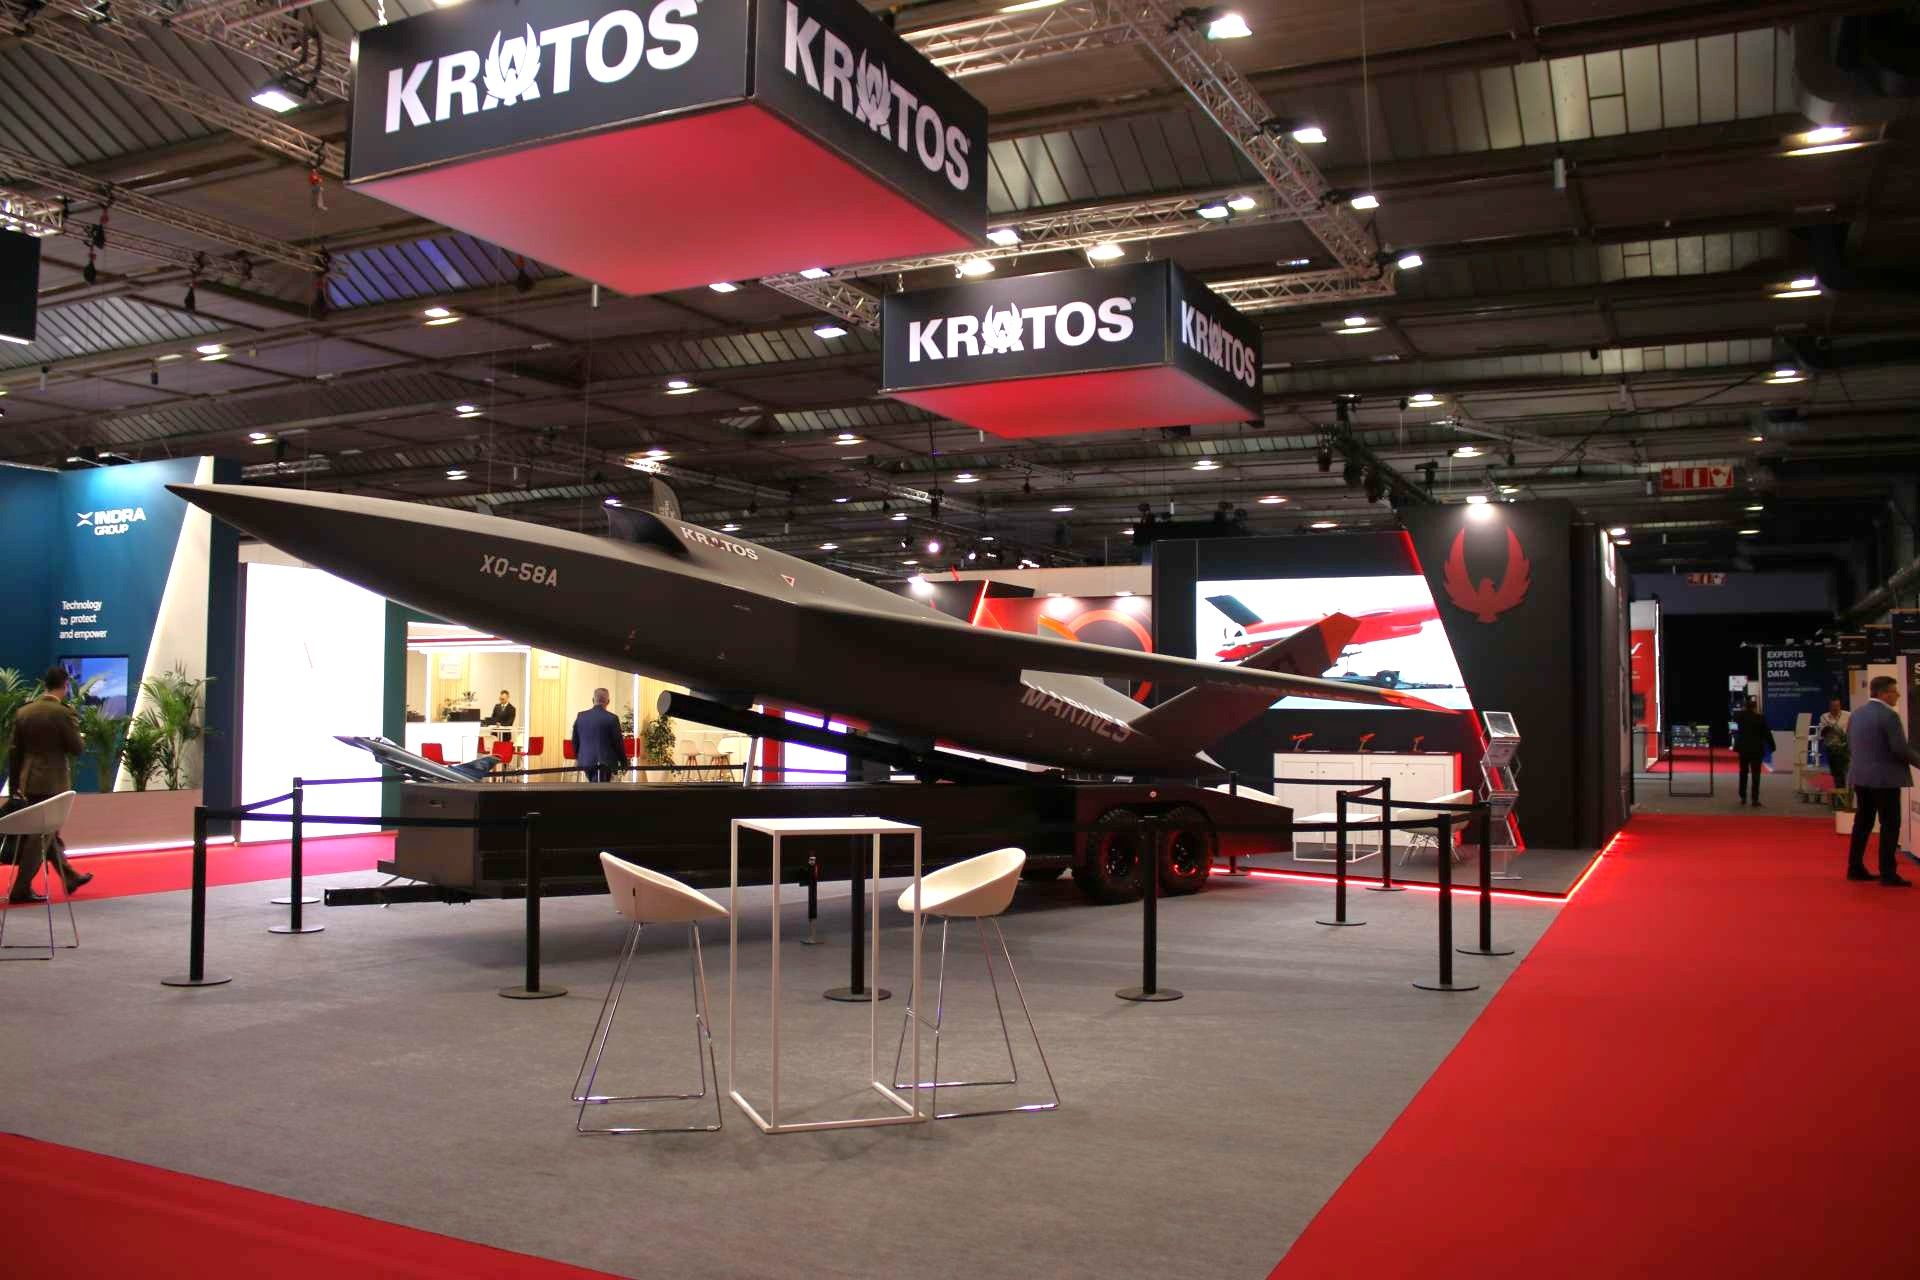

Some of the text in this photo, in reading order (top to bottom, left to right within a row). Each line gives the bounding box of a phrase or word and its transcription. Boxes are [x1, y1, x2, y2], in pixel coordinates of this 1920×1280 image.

[384, 0, 699, 133] KRATOS
[784, 0, 969, 191] KRATOS
[908, 296, 1134, 362] KRATOS
[94, 507, 146, 525] INDRA
[94, 524, 129, 535] GROUP
[480, 554, 558, 587] XQ-58A
[62, 600, 102, 611] Technology
[60, 614, 97, 625] to protect
[60, 630, 107, 639] and empower
[1767, 650, 1804, 658] EXPERTS
[1767, 660, 1807, 668] SYSTEMS
[1767, 670, 1790, 678] DATA
